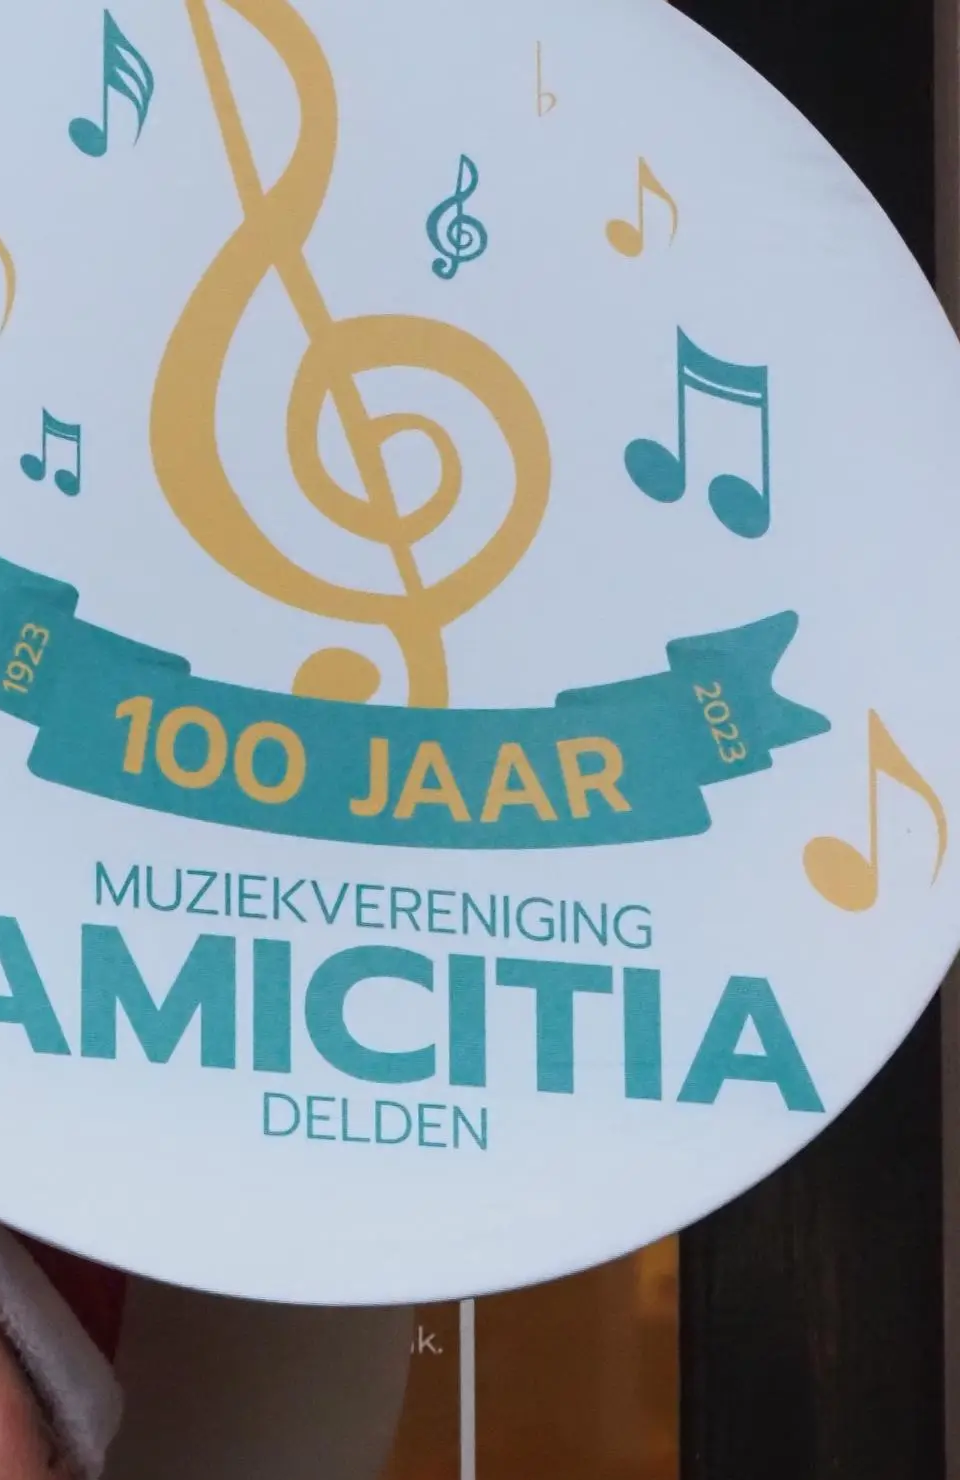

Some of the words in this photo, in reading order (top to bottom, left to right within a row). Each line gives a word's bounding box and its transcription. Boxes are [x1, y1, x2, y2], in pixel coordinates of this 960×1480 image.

[1, 622, 50, 694] 1923
[115, 695, 307, 805] 100
[349, 736, 633, 824] JAAR
[692, 680, 748, 764] 2023
[94, 860, 654, 950] MUZIEKVERENIGING
[262, 1091, 489, 1151] DELDEN
[410, 1325, 444, 1354] k.
